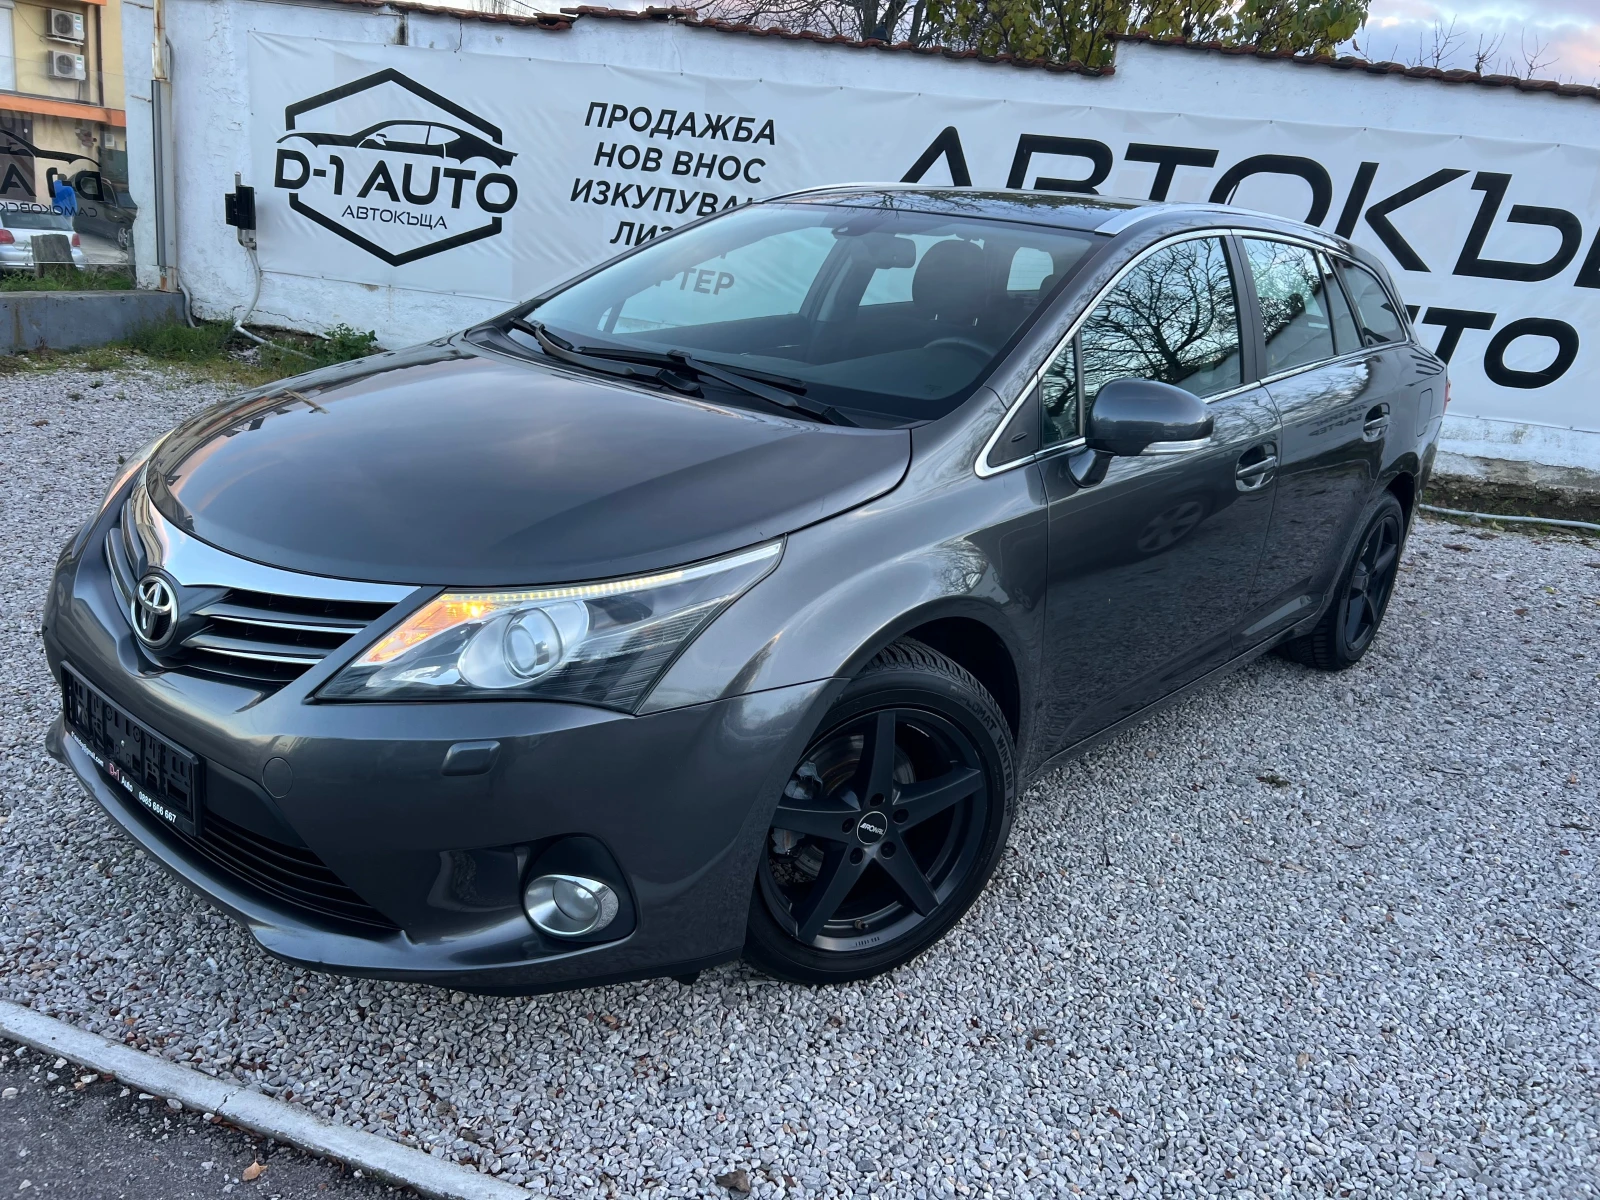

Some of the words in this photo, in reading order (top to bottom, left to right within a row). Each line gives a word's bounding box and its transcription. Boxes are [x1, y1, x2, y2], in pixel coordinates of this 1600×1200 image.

[584, 101, 776, 146] ПРОДАЖБА
[274, 149, 345, 195] D-1
[357, 159, 518, 214] AUTO
[593, 142, 662, 173] НОВ
[671, 149, 766, 184] ВНОС
[341, 205, 448, 230] АВТОКЪЩА
[570, 178, 752, 217] ИЗКУПУВА
[900, 126, 1600, 289] АВТОКЪ
[996, 735, 1014, 791] WINTER
[164, 809, 177, 823] 667
